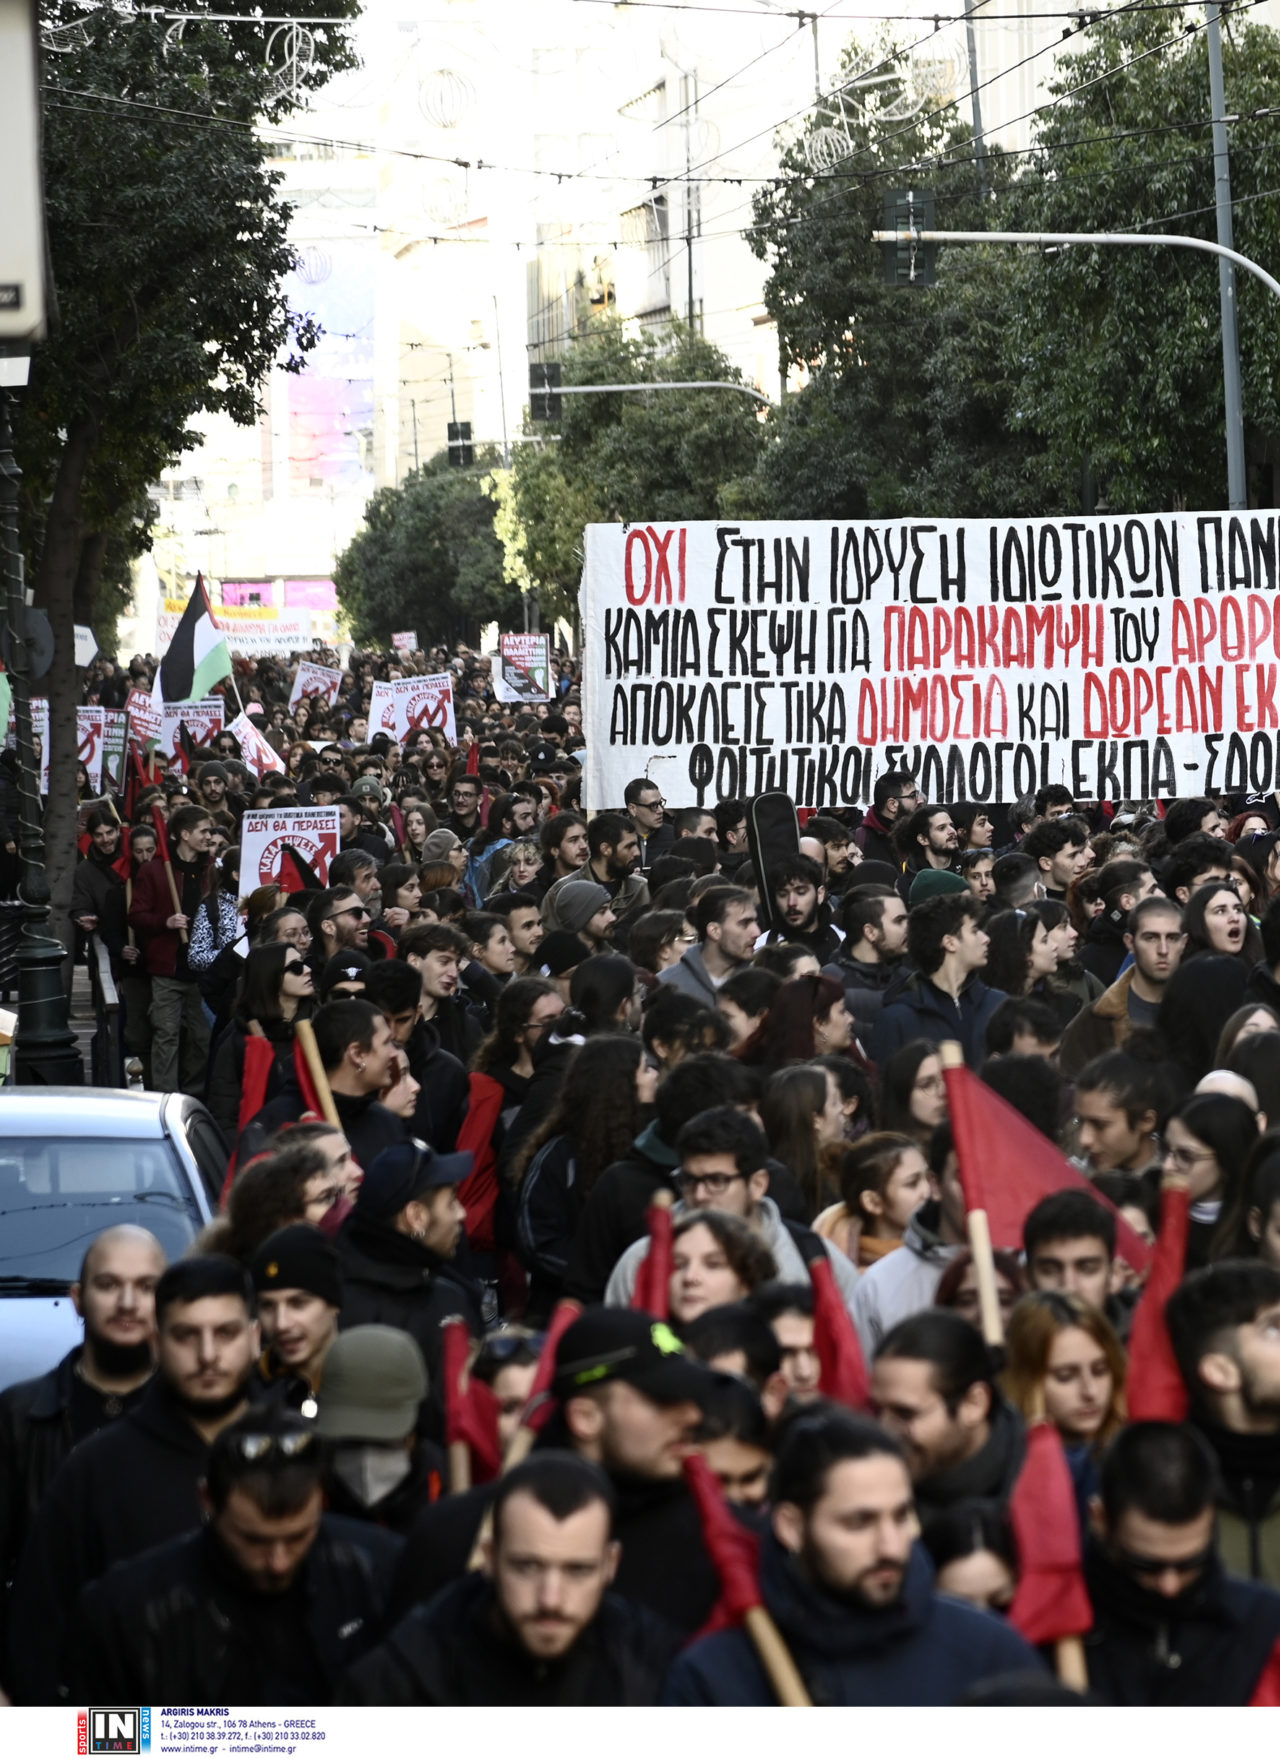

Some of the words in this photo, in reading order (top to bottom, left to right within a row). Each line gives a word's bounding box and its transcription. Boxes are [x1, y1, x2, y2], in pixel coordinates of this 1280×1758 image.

[625, 526, 687, 606] ΟΧΙ
[715, 527, 809, 604] ΣΤΗΝ
[830, 524, 966, 605] ΙΔΡΥΣΗ
[990, 518, 1181, 602] ΙΔΙΩΤΙΚΩΝ
[604, 608, 701, 679] ΚΑΜΙΑ
[706, 608, 818, 678] ΣΚΕΨΗ
[827, 607, 871, 673] ΓΙΑ
[883, 603, 1104, 671] ΠΑΡΑΚΑΜΨΗ
[1110, 607, 1159, 663] ΤΟΥ
[609, 681, 846, 746] ΑΠΟΚΛΕΙΣΤΙΚΑ
[857, 674, 1008, 746] ΔΗΜΟΣΙΑ
[1018, 682, 1069, 741] ΚΑΙ
[1083, 665, 1223, 739] ΔΩΡΕΑΝ
[689, 743, 873, 807] ΦΟΙΤΗΤΙΚΟΙ
[247, 820, 268, 832] ΔΕΝ
[273, 820, 287, 832] ΘΑ
[292, 819, 336, 831] ΠΕΡΑΣΕΙ
